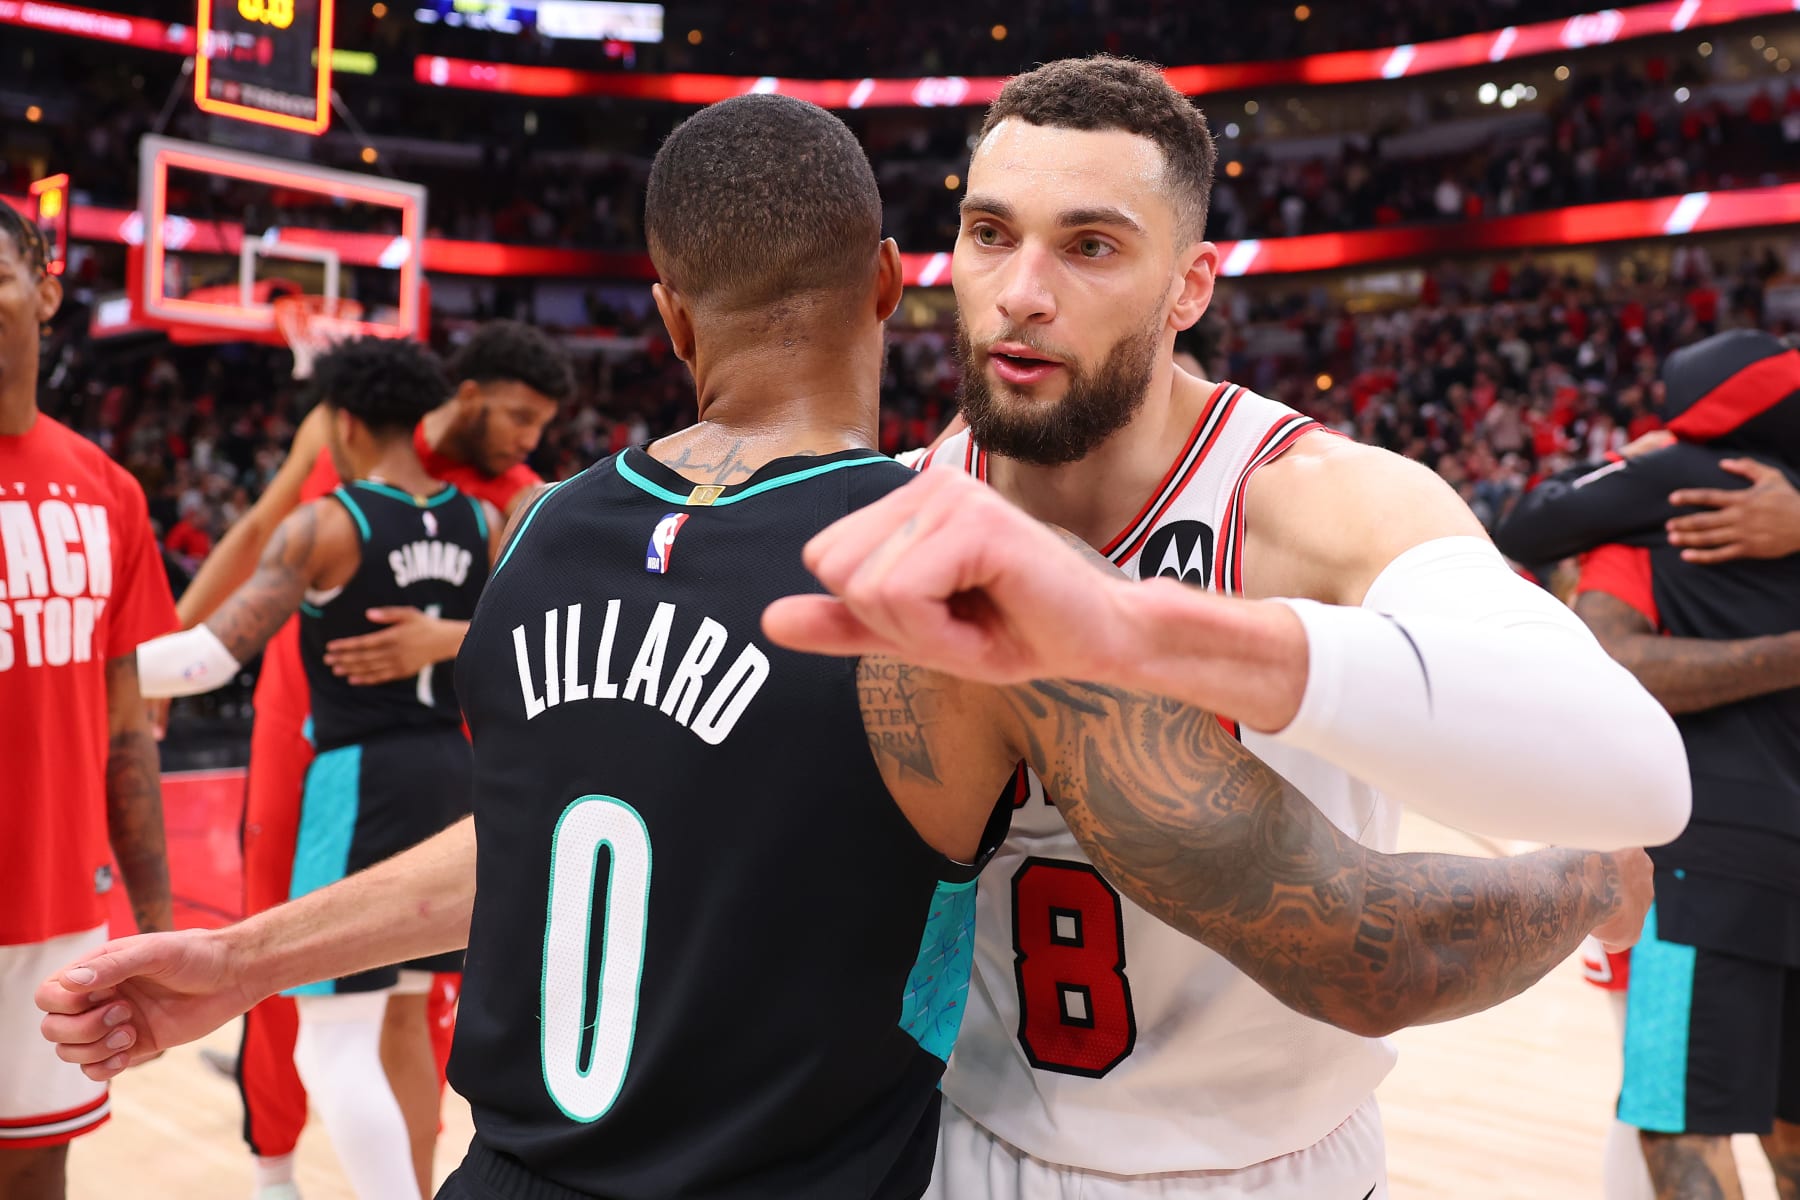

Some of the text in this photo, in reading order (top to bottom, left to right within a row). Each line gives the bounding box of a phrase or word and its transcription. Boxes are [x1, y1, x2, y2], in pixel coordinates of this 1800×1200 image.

[0, 500, 113, 600] ACK
[388, 540, 472, 588] SIMONS
[512, 599, 770, 745] LILLARD
[540, 794, 653, 1124] 0
[1011, 855, 1137, 1080] 8
